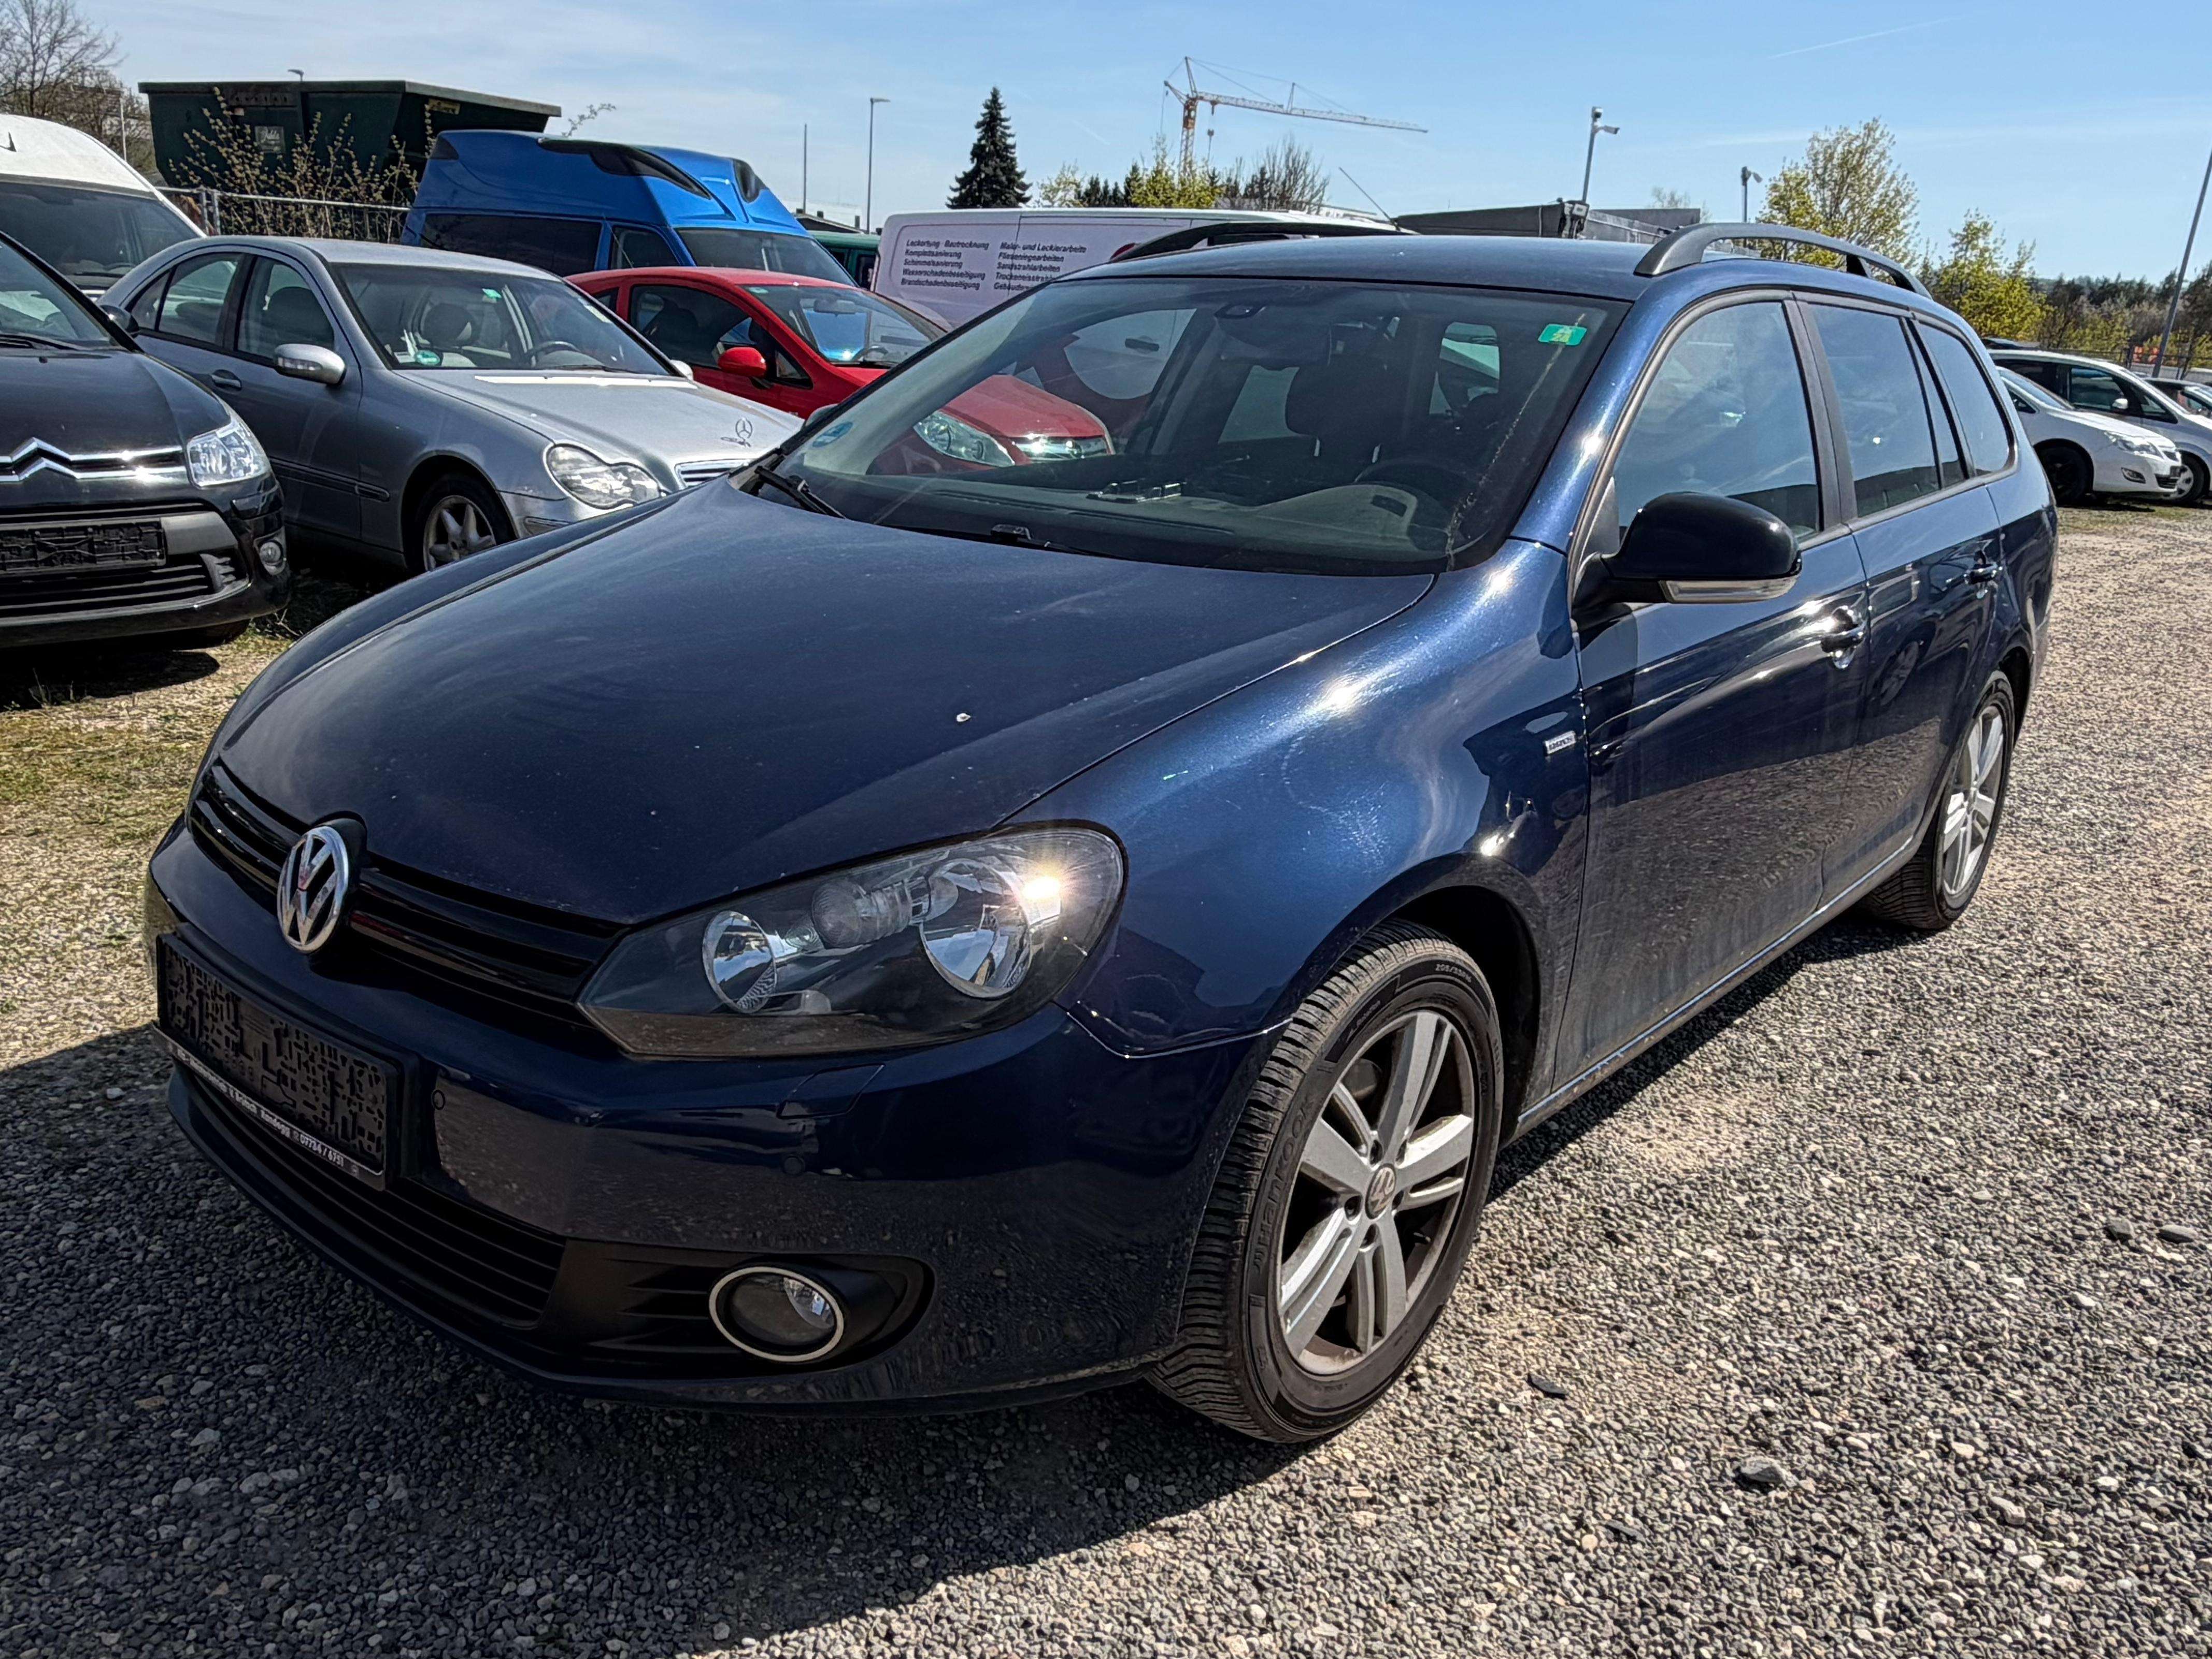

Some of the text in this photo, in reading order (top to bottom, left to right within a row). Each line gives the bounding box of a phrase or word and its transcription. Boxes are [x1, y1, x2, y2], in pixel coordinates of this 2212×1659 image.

[907, 239, 990, 250] Leckortung Bautrocknung
[905, 249, 962, 259] Komplettsanierung
[904, 258, 963, 269] Schimmelsanierung
[997, 262, 1060, 272] Sandstrahlarbeiten
[903, 268, 986, 280] Wasserschadenbeseitigung
[901, 278, 980, 291] Brandschadenbeseitigung
